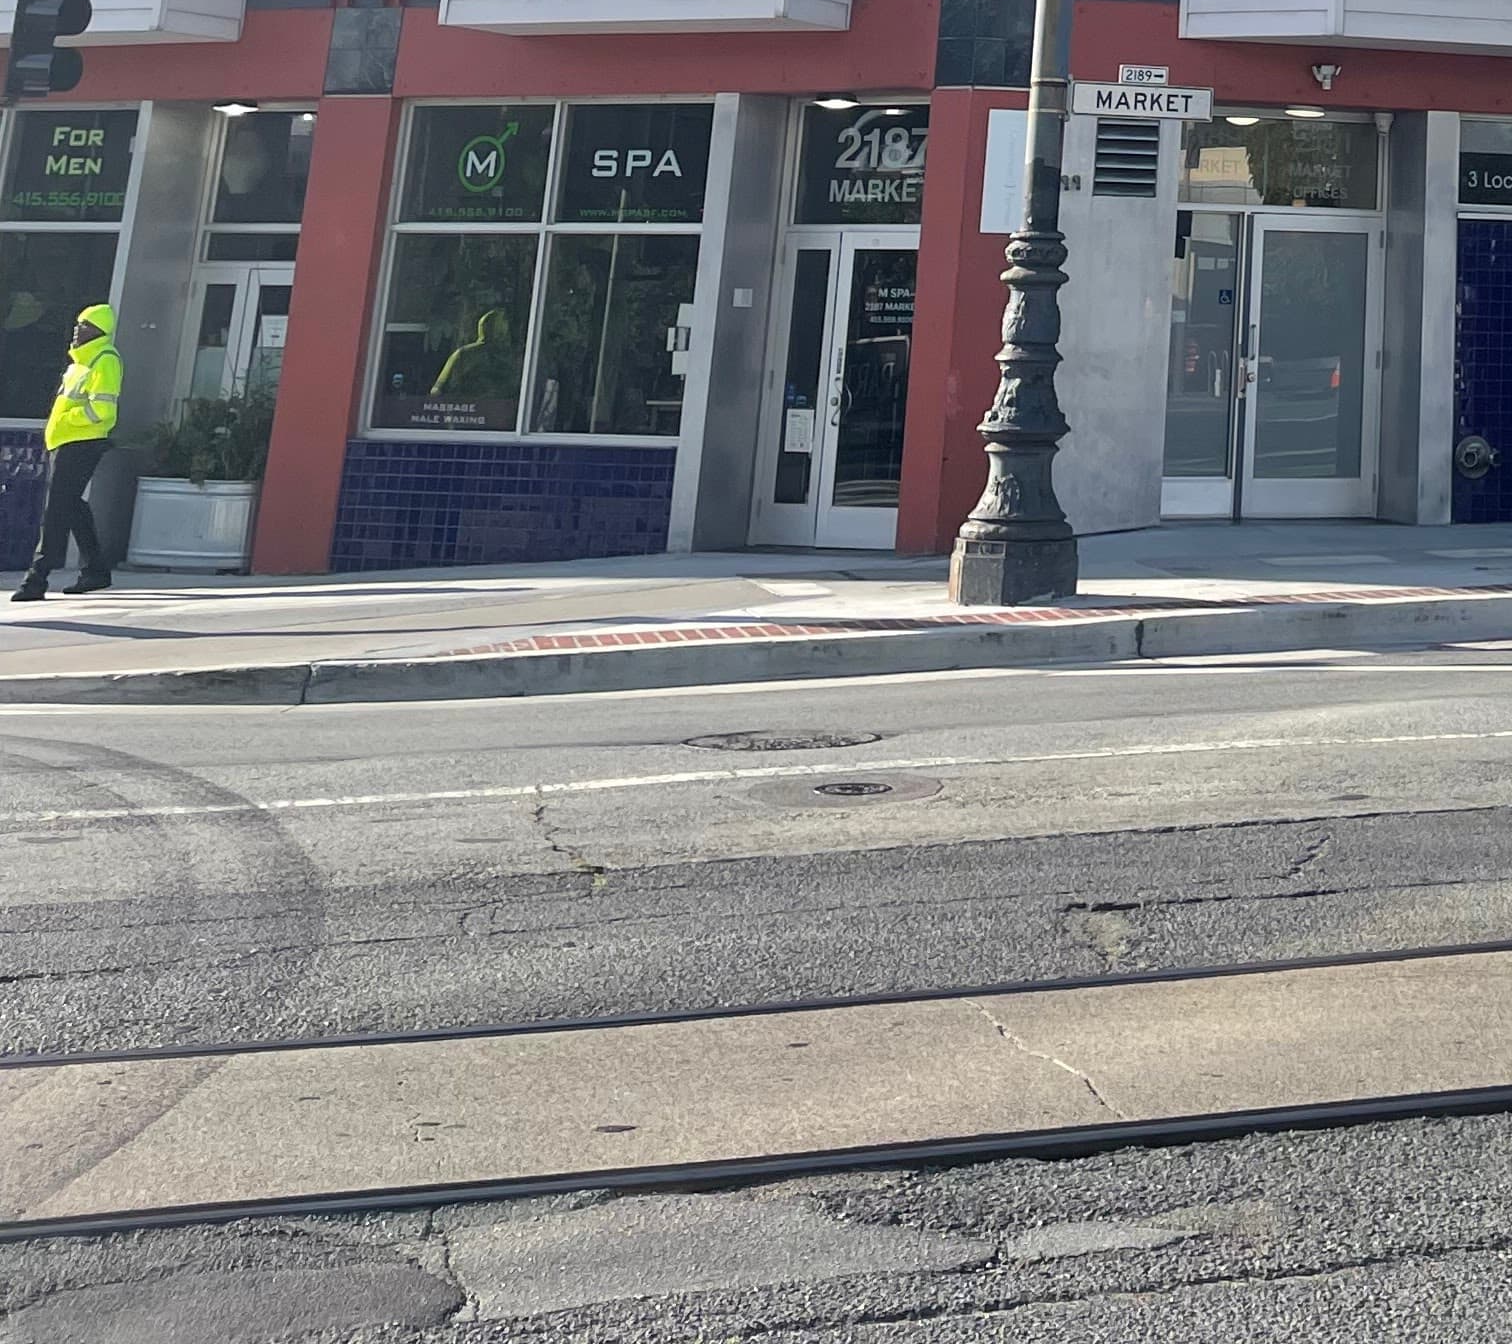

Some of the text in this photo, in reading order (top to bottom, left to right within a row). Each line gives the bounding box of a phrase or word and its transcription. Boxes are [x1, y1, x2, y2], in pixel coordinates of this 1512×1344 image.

[1125, 69, 1152, 81] 2189
[1096, 90, 1193, 113] MARKET
[835, 127, 929, 169] 2187
[465, 149, 683, 178] M SPA
[829, 179, 918, 202] MARKE
[1468, 171, 1478, 188] 3
